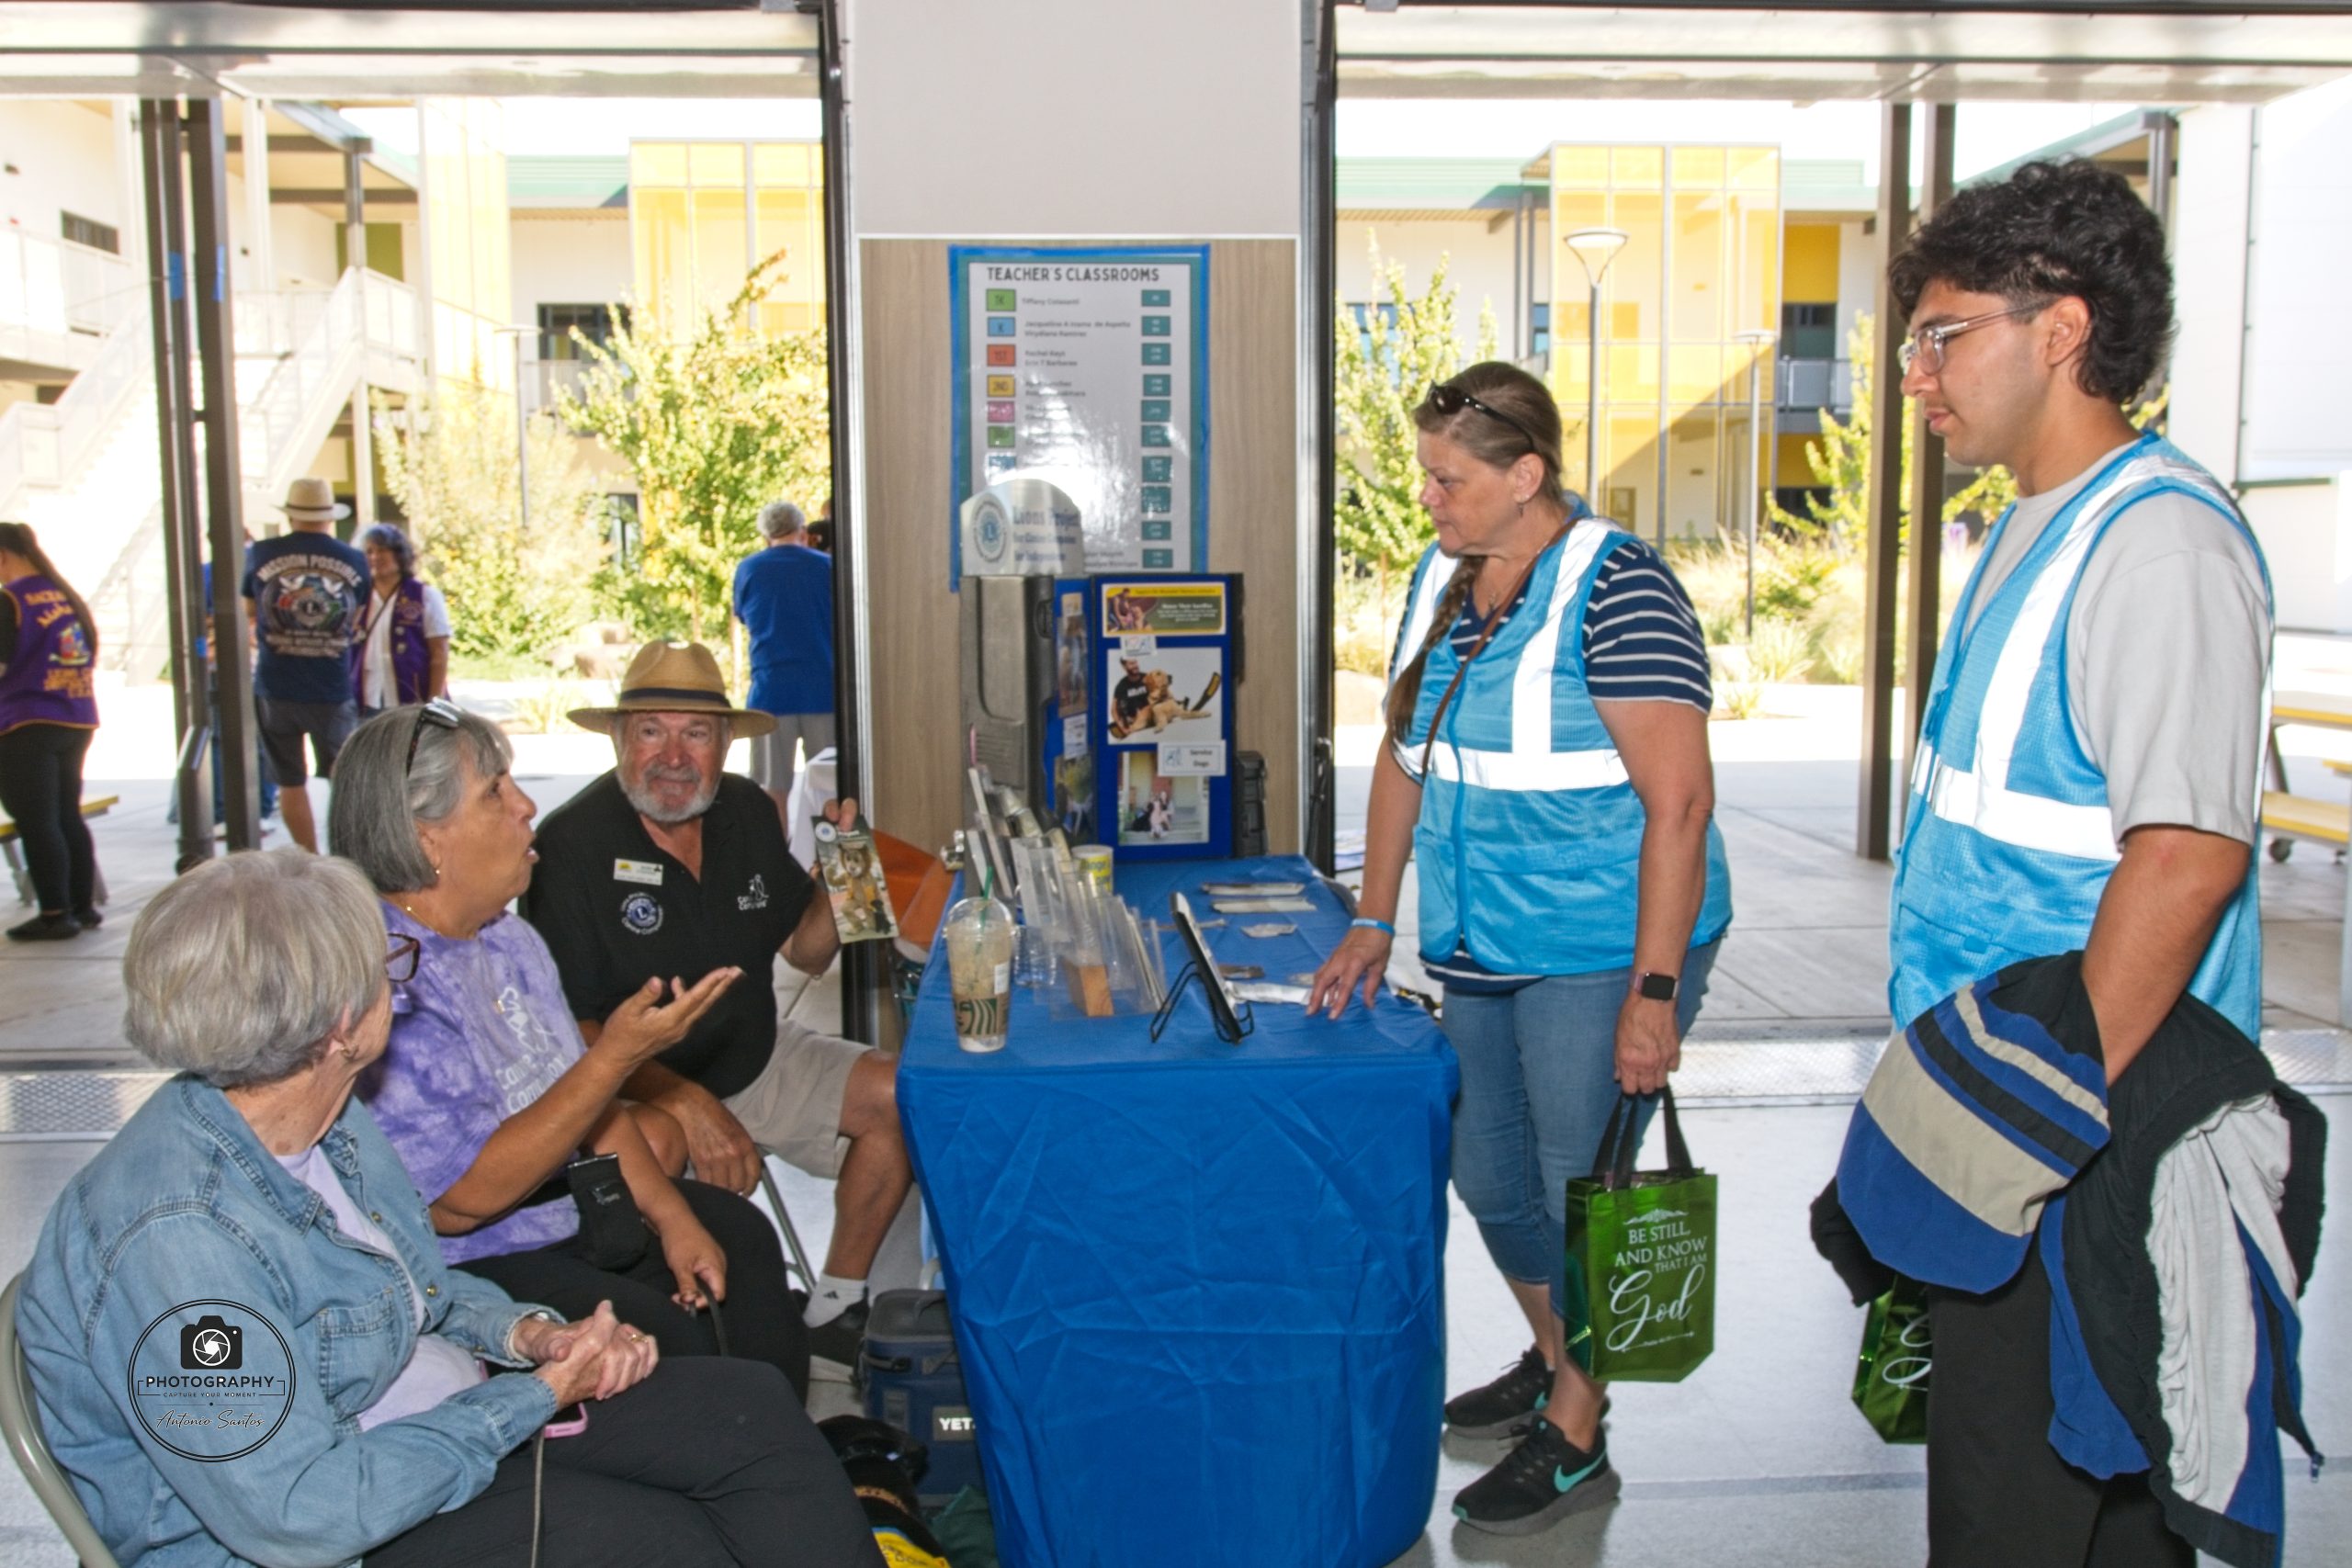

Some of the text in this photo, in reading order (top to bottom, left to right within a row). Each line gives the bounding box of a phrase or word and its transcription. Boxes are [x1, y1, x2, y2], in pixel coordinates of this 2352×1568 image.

[1065, 267, 1159, 283] CLASSROOMS
[1628, 1227, 1647, 1245] BE
[1614, 1235, 1708, 1268] AND KNOW
[1655, 1252, 1707, 1274] THAT I AM
[1606, 1264, 1706, 1352] God
[938, 1416, 976, 1431] YET
